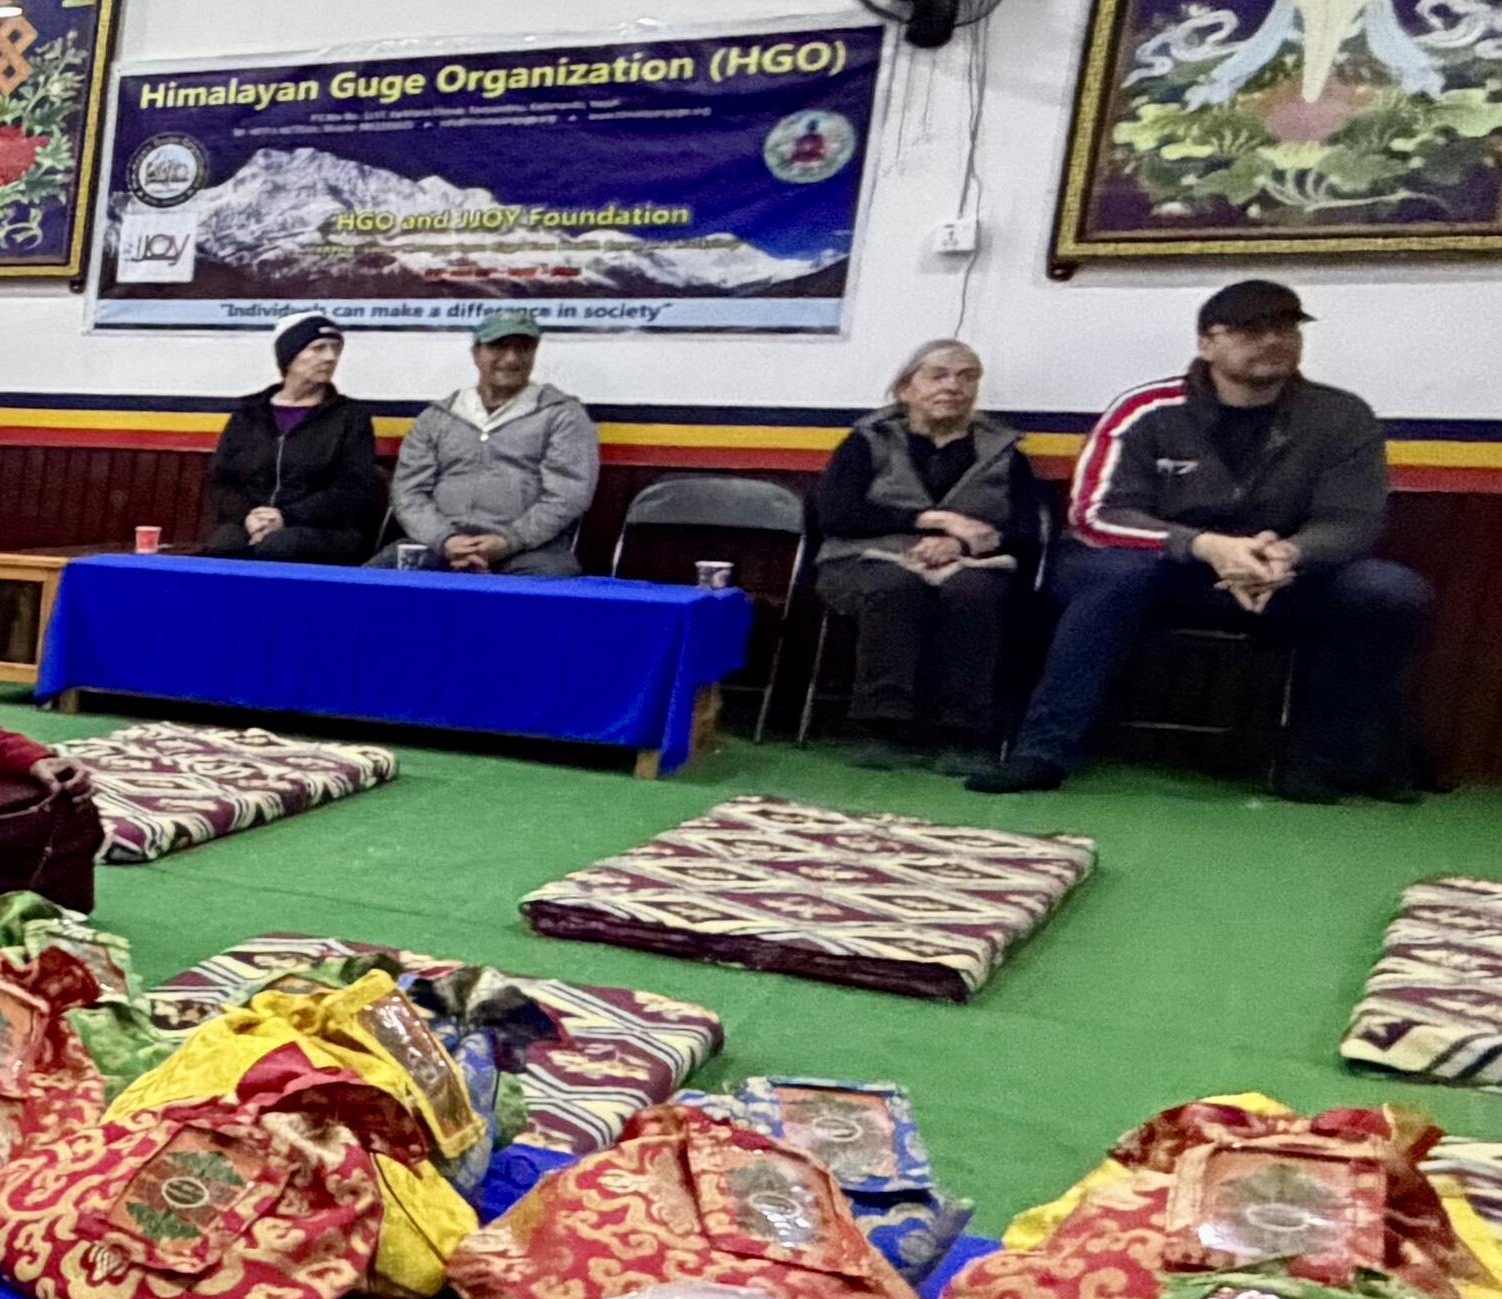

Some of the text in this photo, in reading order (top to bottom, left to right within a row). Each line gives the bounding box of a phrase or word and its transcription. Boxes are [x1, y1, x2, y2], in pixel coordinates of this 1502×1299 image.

[139, 77, 319, 111] Himalayan
[330, 70, 426, 104] Guge
[436, 51, 694, 98] Organization
[709, 40, 848, 83] (HGO)
[336, 210, 395, 231] HGO
[401, 209, 448, 230] and
[529, 203, 691, 227] Foundation
[332, 304, 365, 317] can
[370, 303, 423, 318] make
[428, 306, 439, 318] a
[557, 303, 577, 318] in
